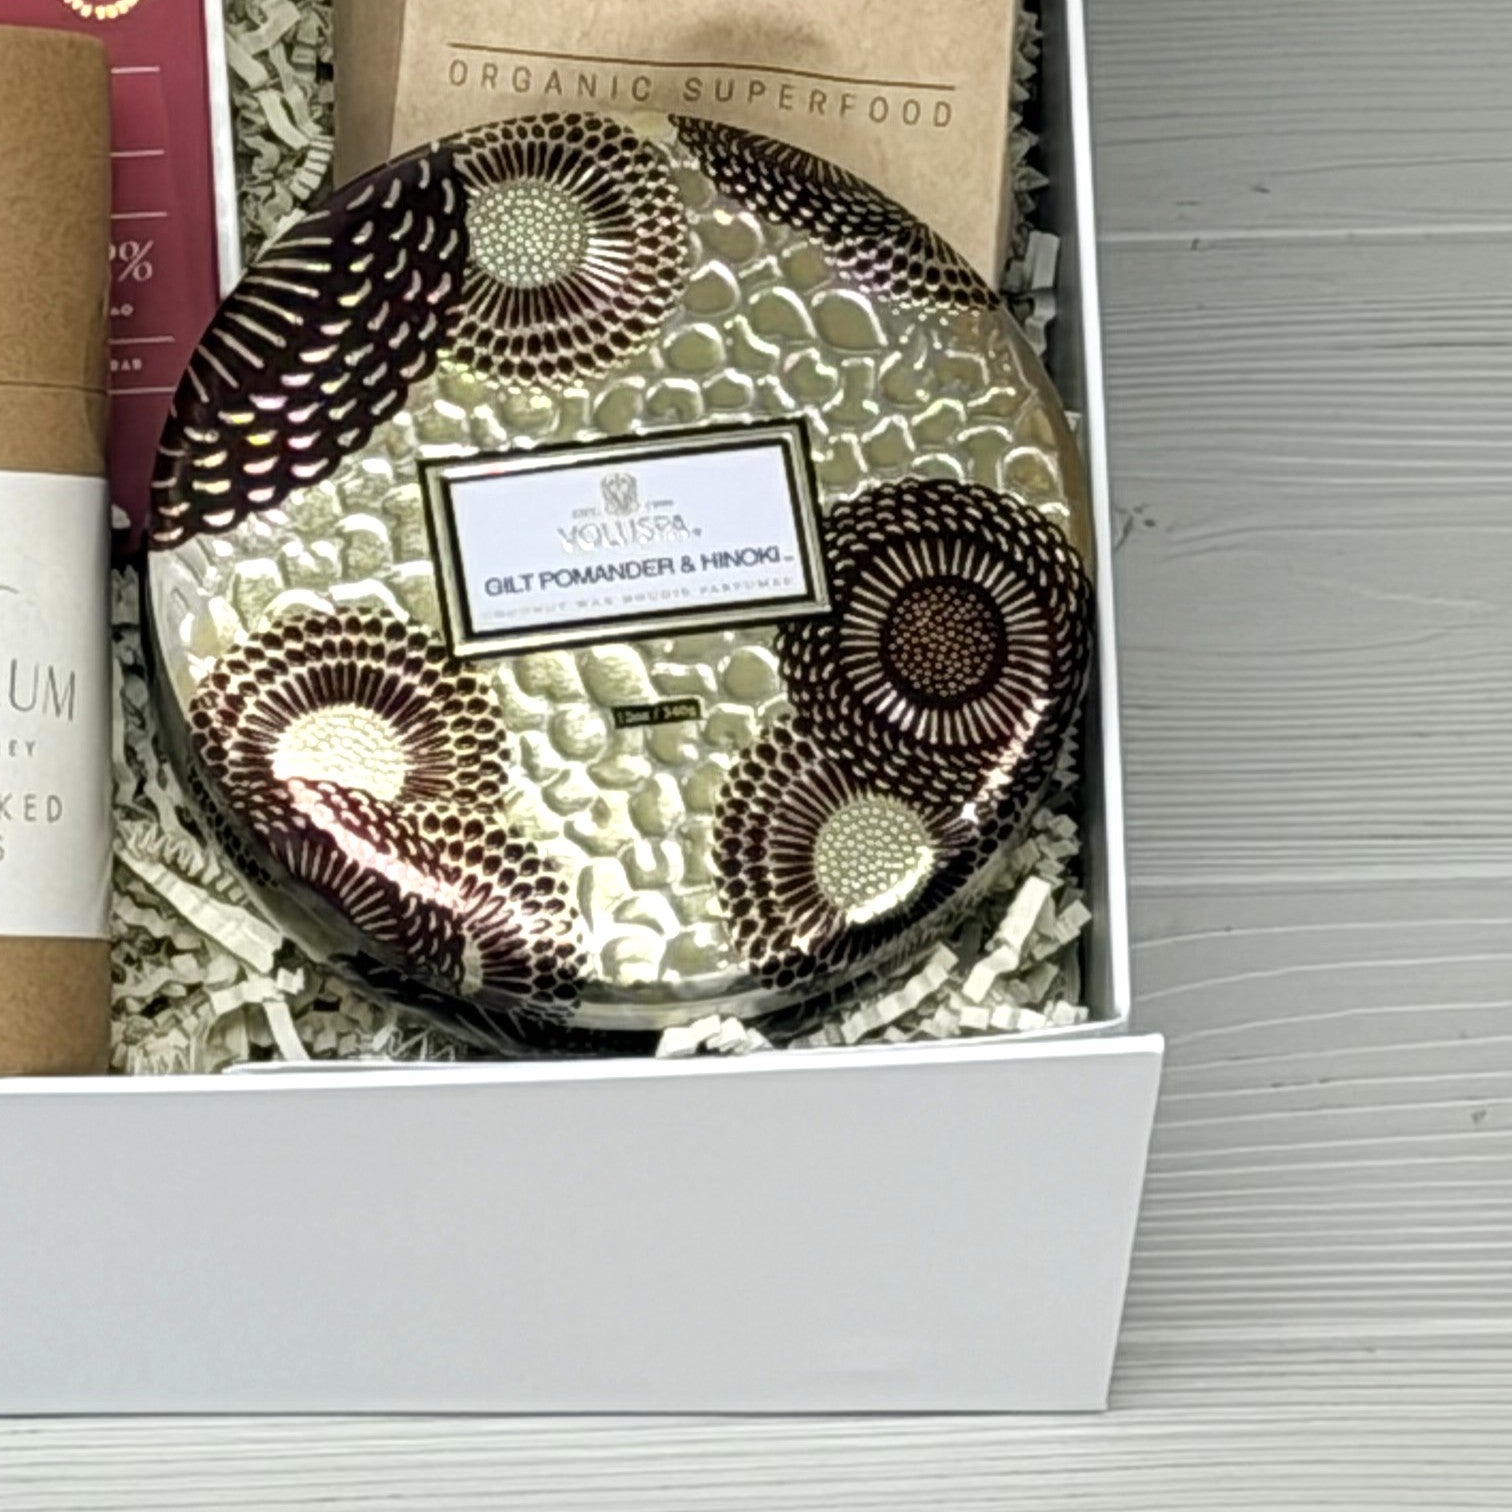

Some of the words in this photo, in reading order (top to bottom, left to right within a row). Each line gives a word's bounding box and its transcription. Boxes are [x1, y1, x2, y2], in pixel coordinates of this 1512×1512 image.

[447, 59, 654, 104] ORGANIC
[682, 75, 955, 131] SUPERFOOD
[484, 571, 537, 598] GILT
[539, 558, 675, 592] POMANDER
[680, 555, 697, 573] &
